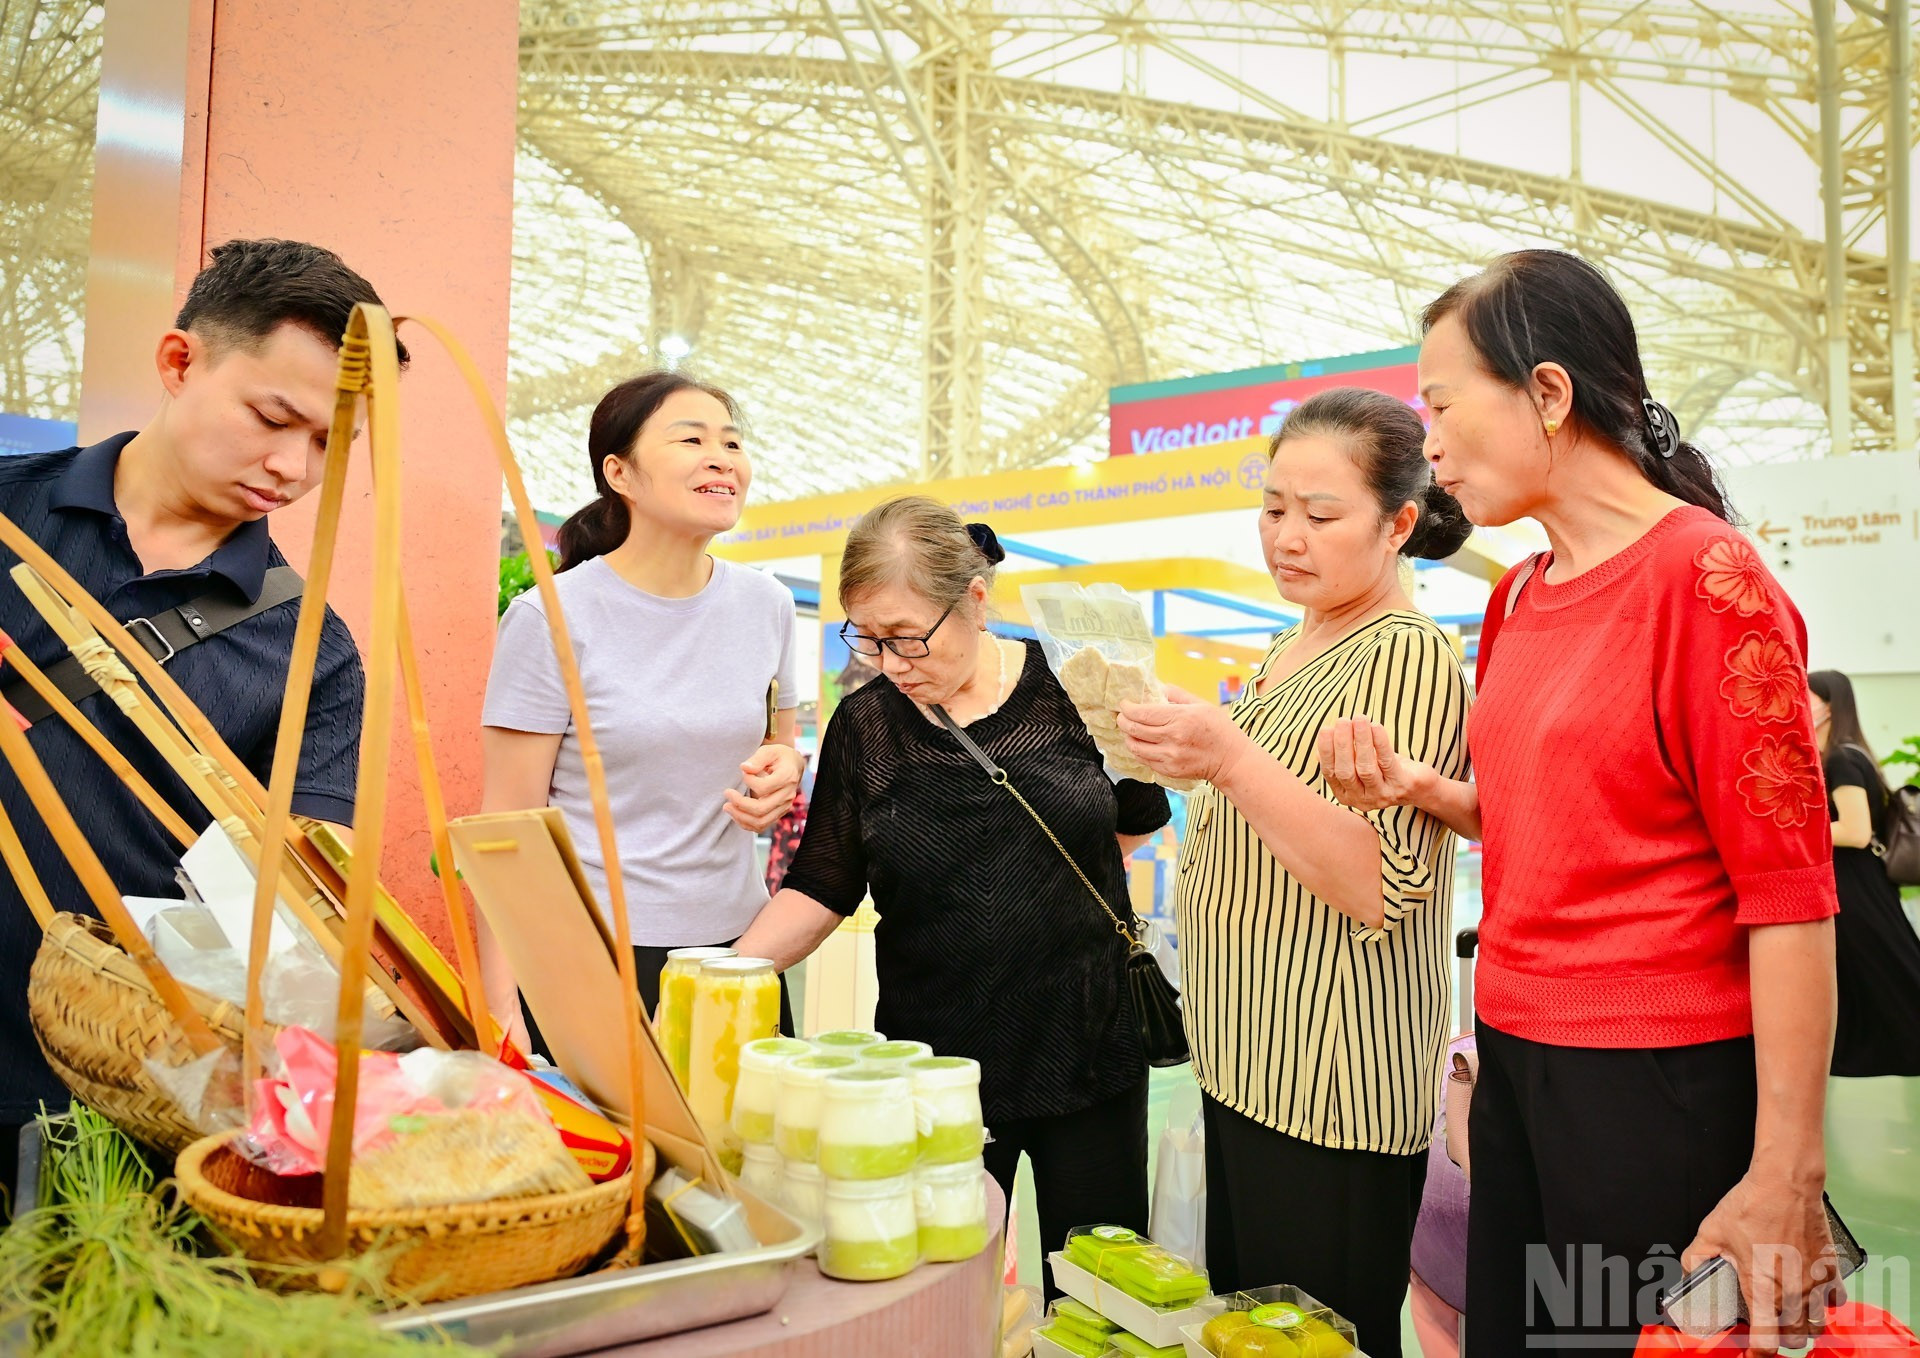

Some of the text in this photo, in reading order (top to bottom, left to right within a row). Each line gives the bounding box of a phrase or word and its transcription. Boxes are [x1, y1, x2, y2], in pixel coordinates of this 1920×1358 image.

[1130, 416, 1254, 455] Vietlott
[993, 492, 1033, 511] NGHỆ
[1037, 491, 1070, 507] CAO
[1075, 483, 1129, 503] THÀNH
[1133, 472, 1168, 496] PHỐ
[1171, 471, 1196, 491] HÀ
[1200, 467, 1231, 490] NỘI
[1802, 511, 1901, 531] Trung tâm
[1802, 532, 1880, 547] Center Hall
